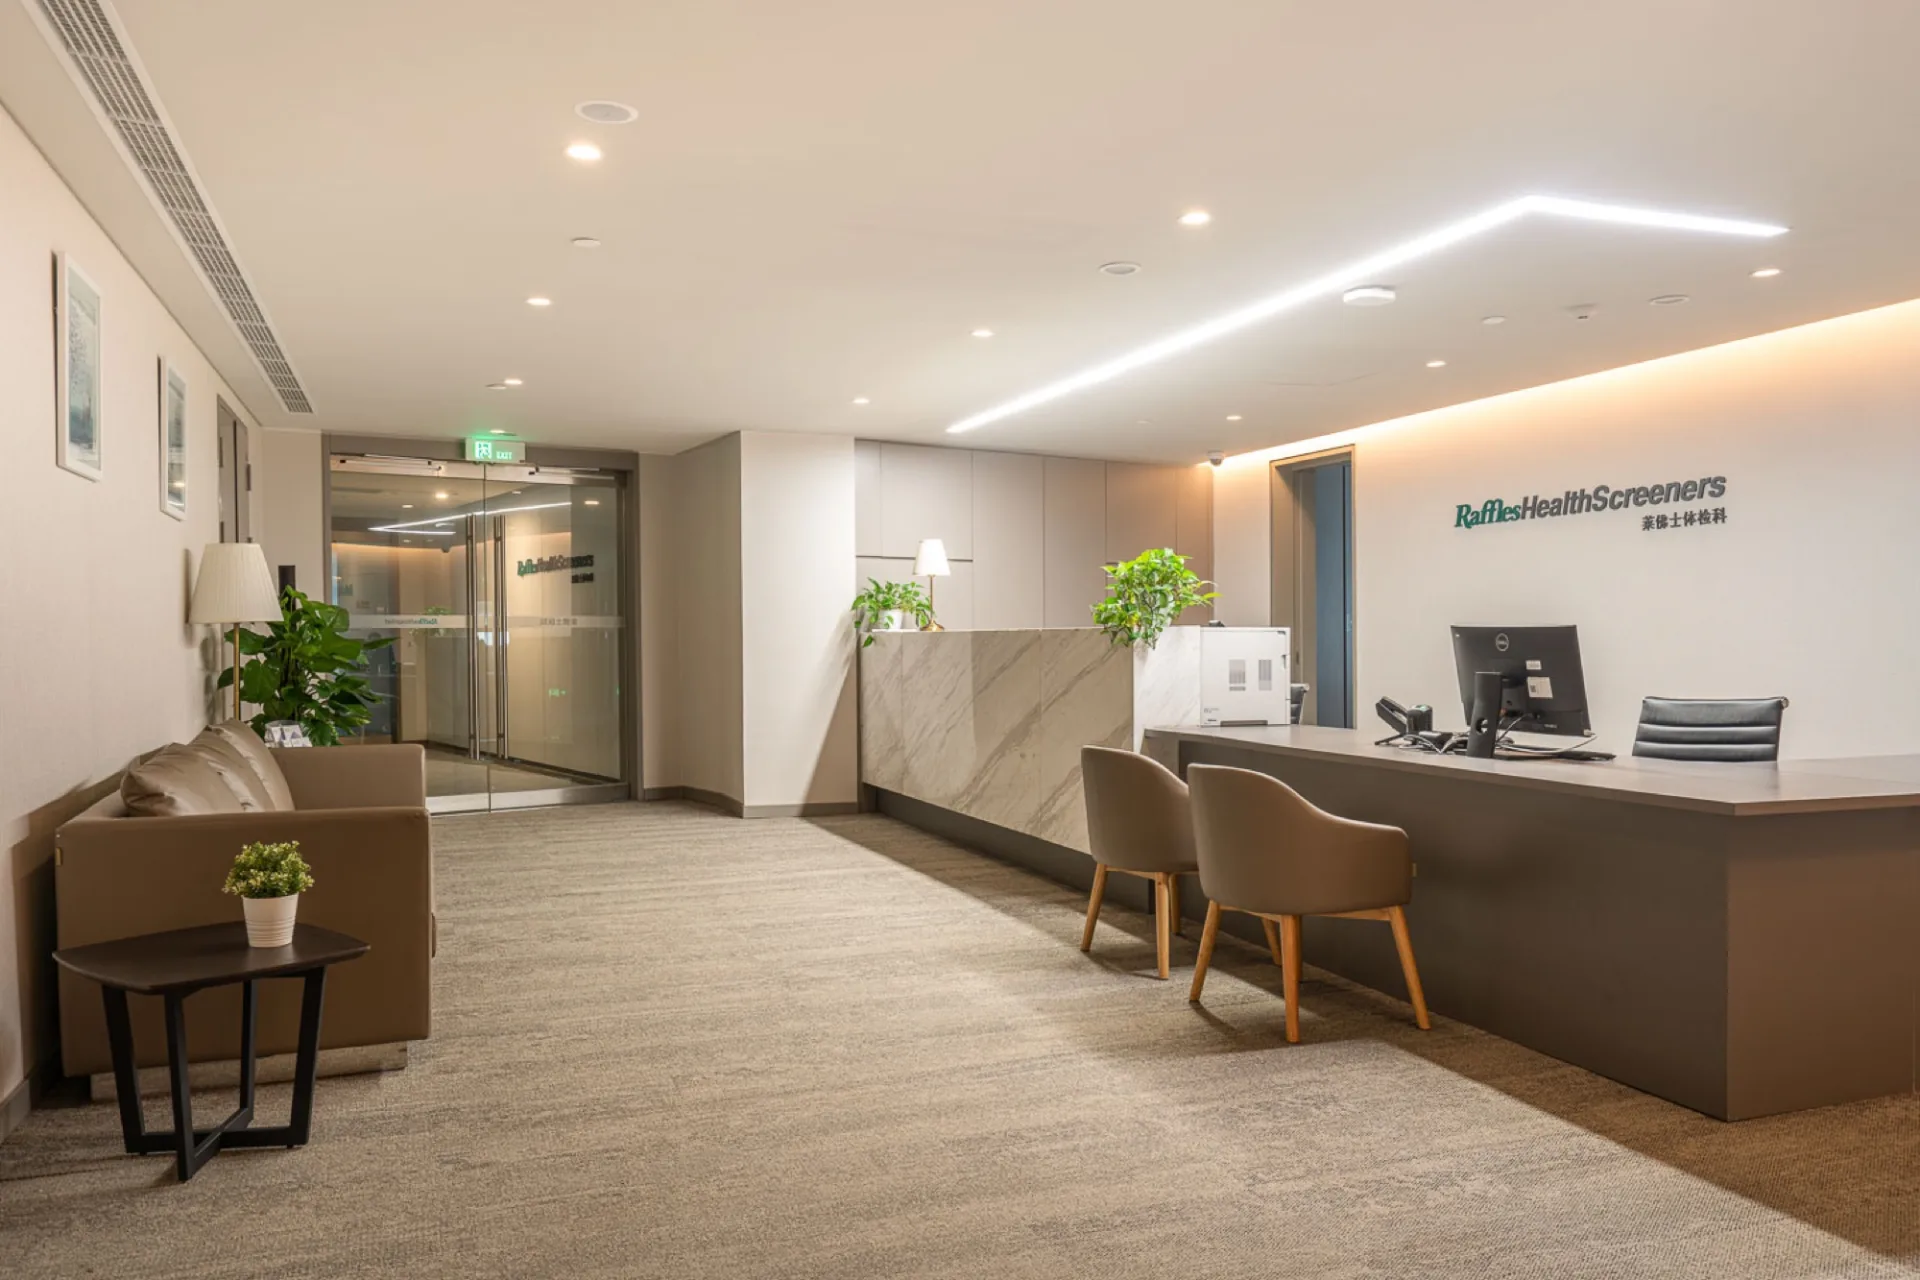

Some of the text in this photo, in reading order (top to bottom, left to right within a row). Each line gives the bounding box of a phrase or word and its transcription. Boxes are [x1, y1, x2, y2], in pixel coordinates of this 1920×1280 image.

[1642, 507, 1727, 531] 莱佛士体检科
